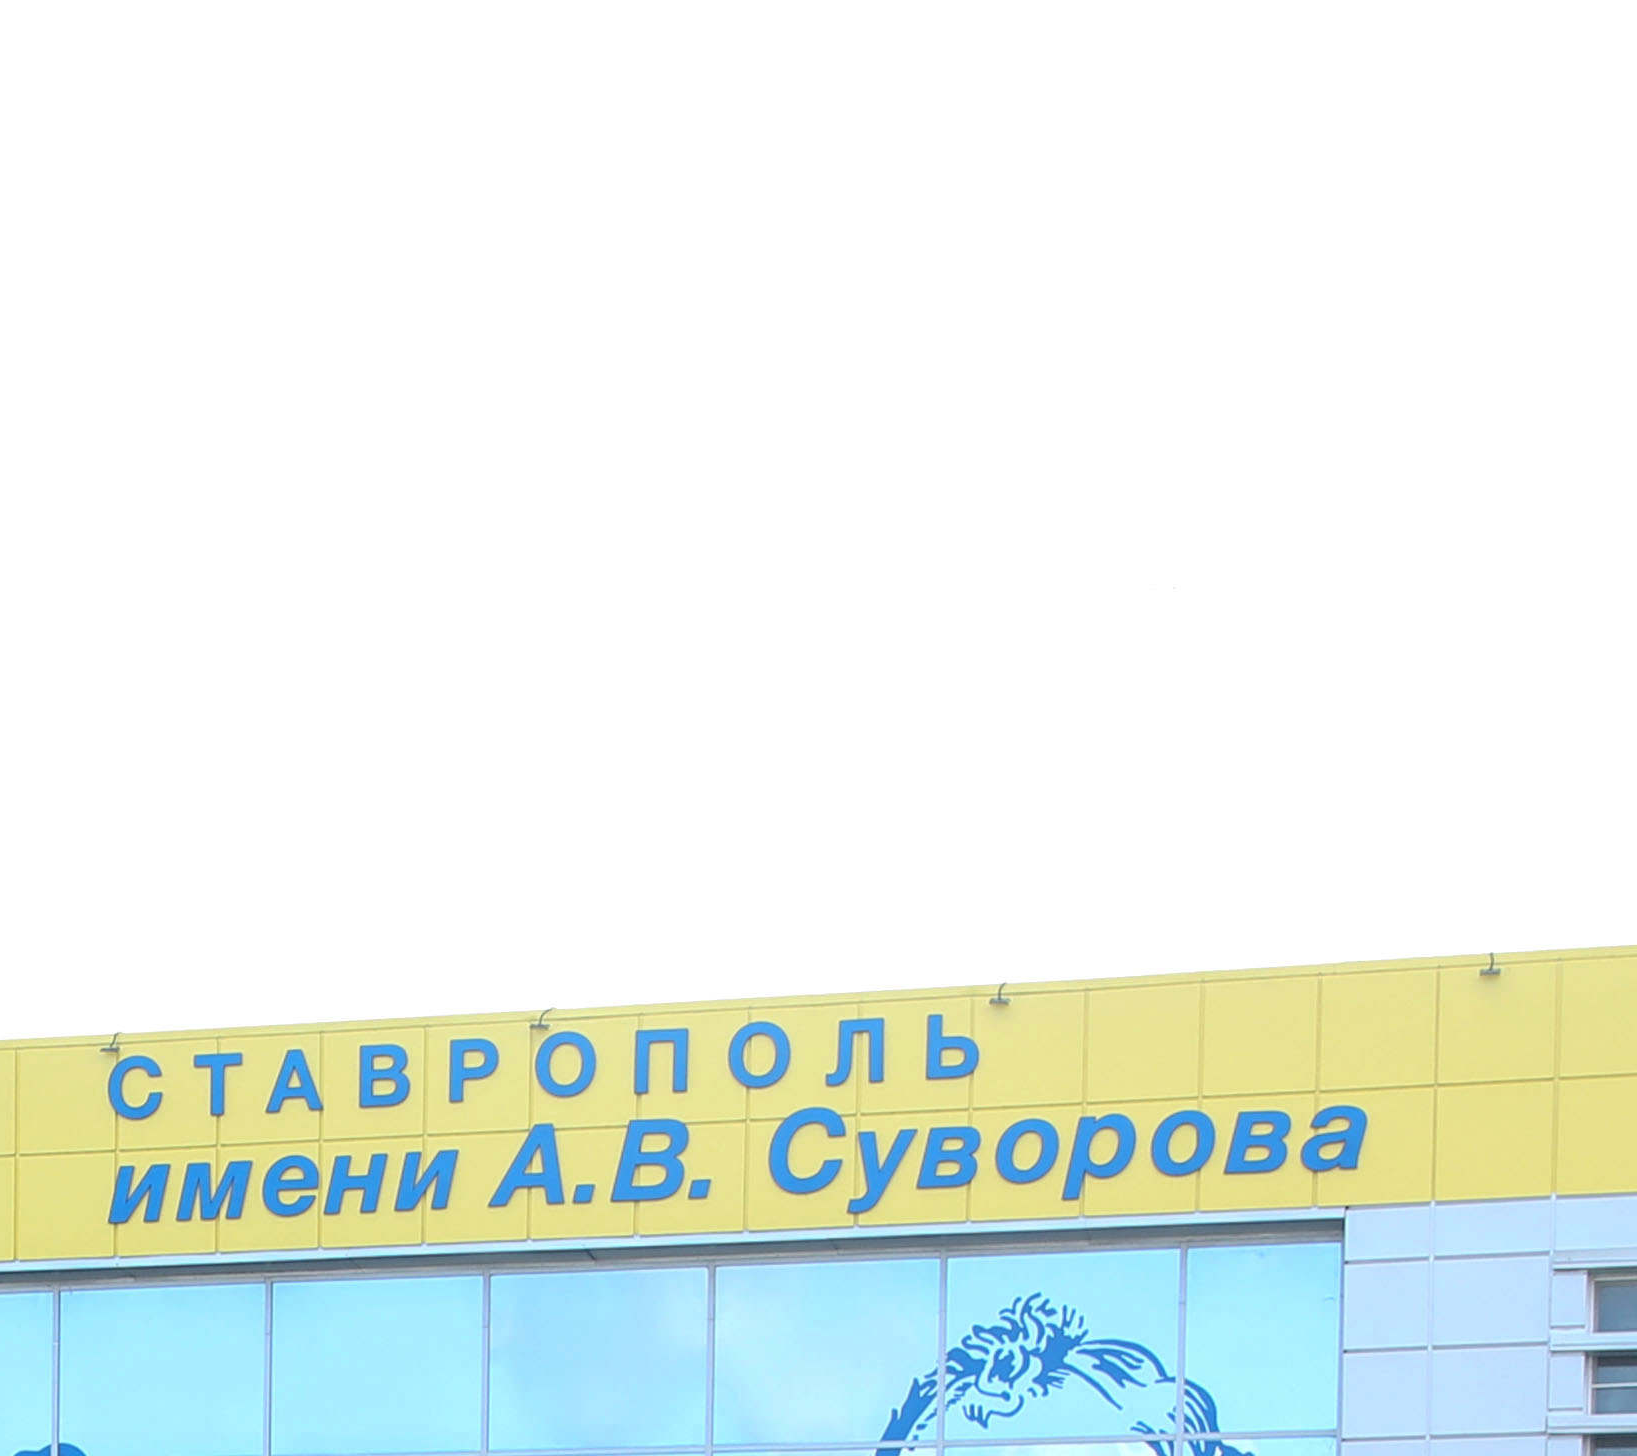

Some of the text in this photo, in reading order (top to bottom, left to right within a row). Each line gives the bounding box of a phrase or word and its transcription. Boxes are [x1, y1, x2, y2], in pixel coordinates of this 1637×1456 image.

[107, 1013, 981, 1119] СТАВРОПОЛЬ
[107, 1104, 1370, 1224] имени А.В. Суворова
